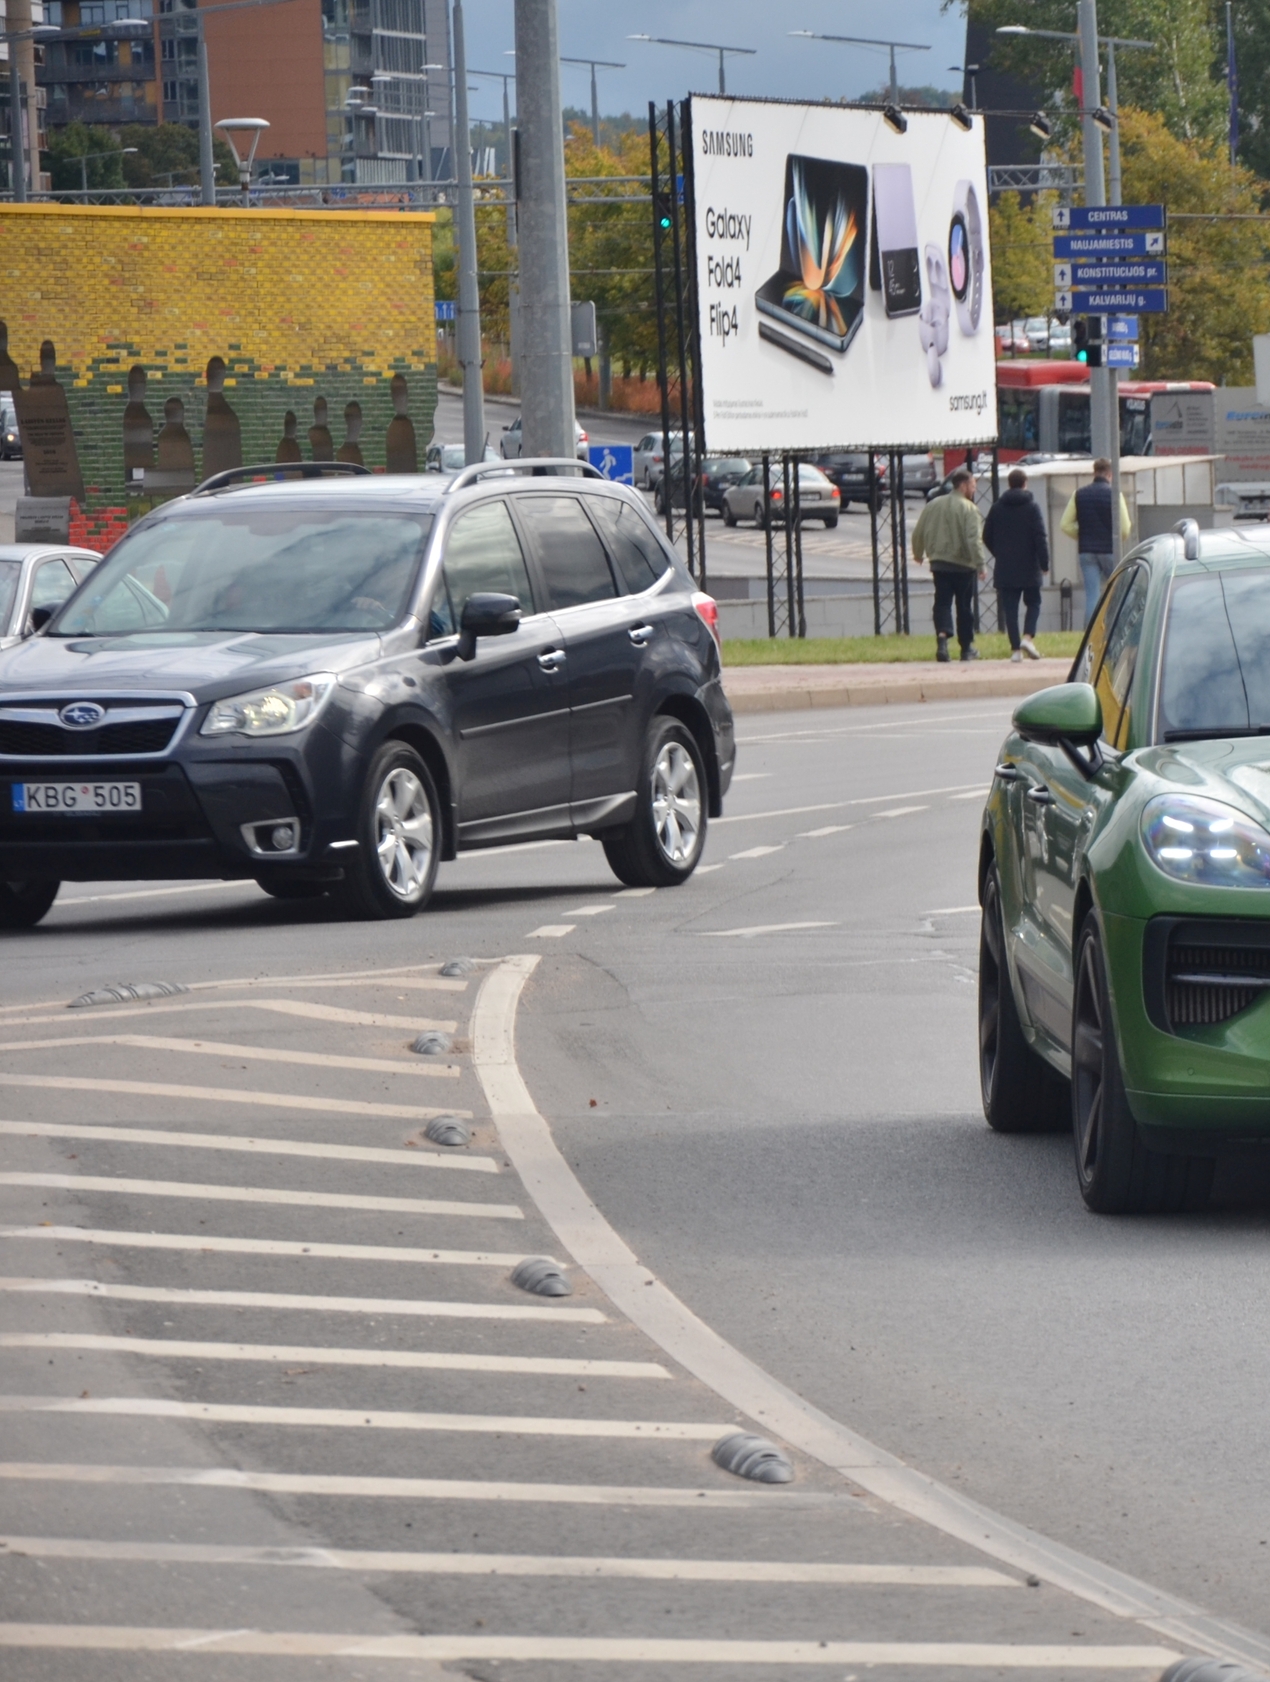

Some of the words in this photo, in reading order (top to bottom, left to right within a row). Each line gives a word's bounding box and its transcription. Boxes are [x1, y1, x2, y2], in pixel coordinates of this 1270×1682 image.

[702, 129, 753, 158] SAMSUNG
[1088, 210, 1128, 222] CENTRAS
[706, 207, 751, 251] Galaxy
[1070, 238, 1134, 250] NAUJAMIESTIS
[708, 255, 741, 288] Fold4
[1077, 266, 1144, 278] KONSTITUCIJOS
[1147, 269, 1157, 277] pr.
[1089, 294, 1136, 306] KALVARIJŲ
[1138, 297, 1146, 306] g.
[709, 301, 738, 347] Flip4
[949, 391, 987, 416] samsung.lt
[26, 786, 77, 808] KBG
[94, 785, 136, 807] 505
